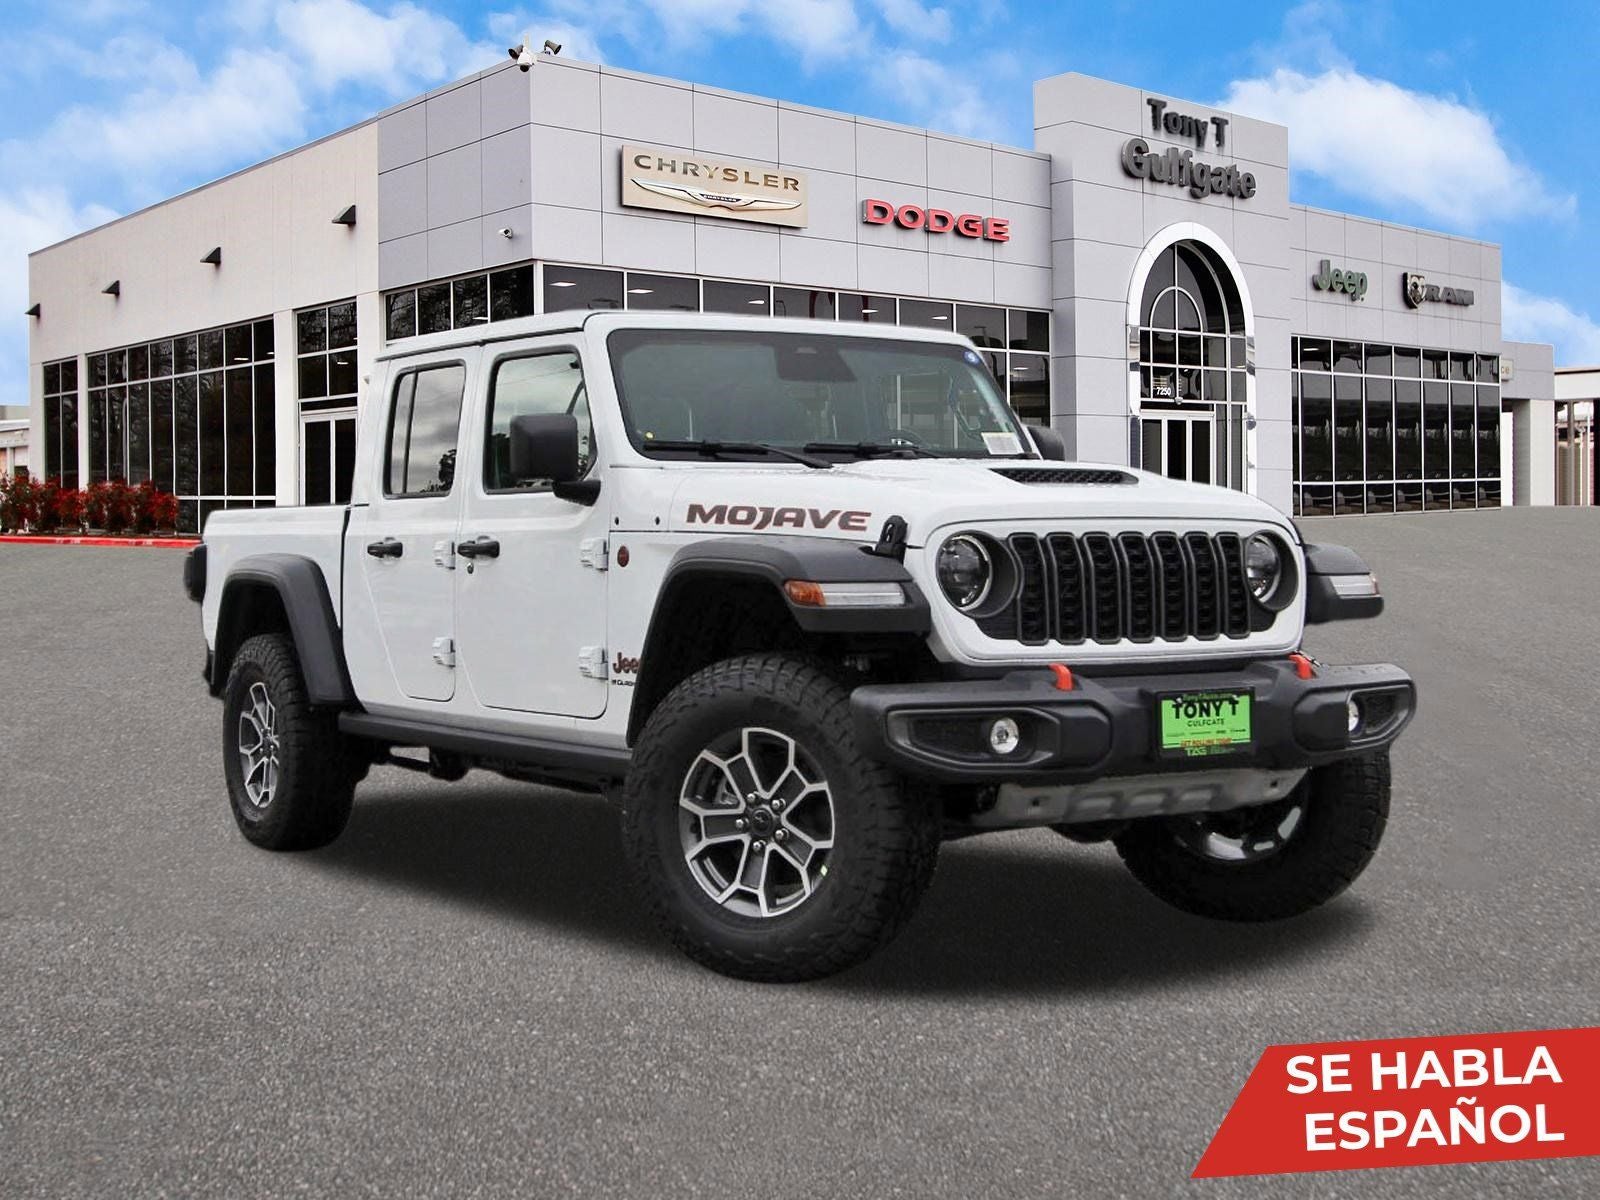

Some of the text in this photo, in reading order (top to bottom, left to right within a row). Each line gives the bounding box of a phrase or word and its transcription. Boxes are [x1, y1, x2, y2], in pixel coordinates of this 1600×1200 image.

[1146, 98, 1229, 148] Tony T
[633, 154, 800, 192] CHRYSLER
[1121, 137, 1257, 199] Gulfgate
[862, 198, 1010, 243] DODGE
[1312, 259, 1369, 301] Jeep
[1424, 284, 1475, 306] RAM
[1156, 386, 1172, 396] 7250
[686, 504, 872, 531] MOJAVE
[612, 651, 640, 674] Jee
[1171, 697, 1239, 719] TONY T
